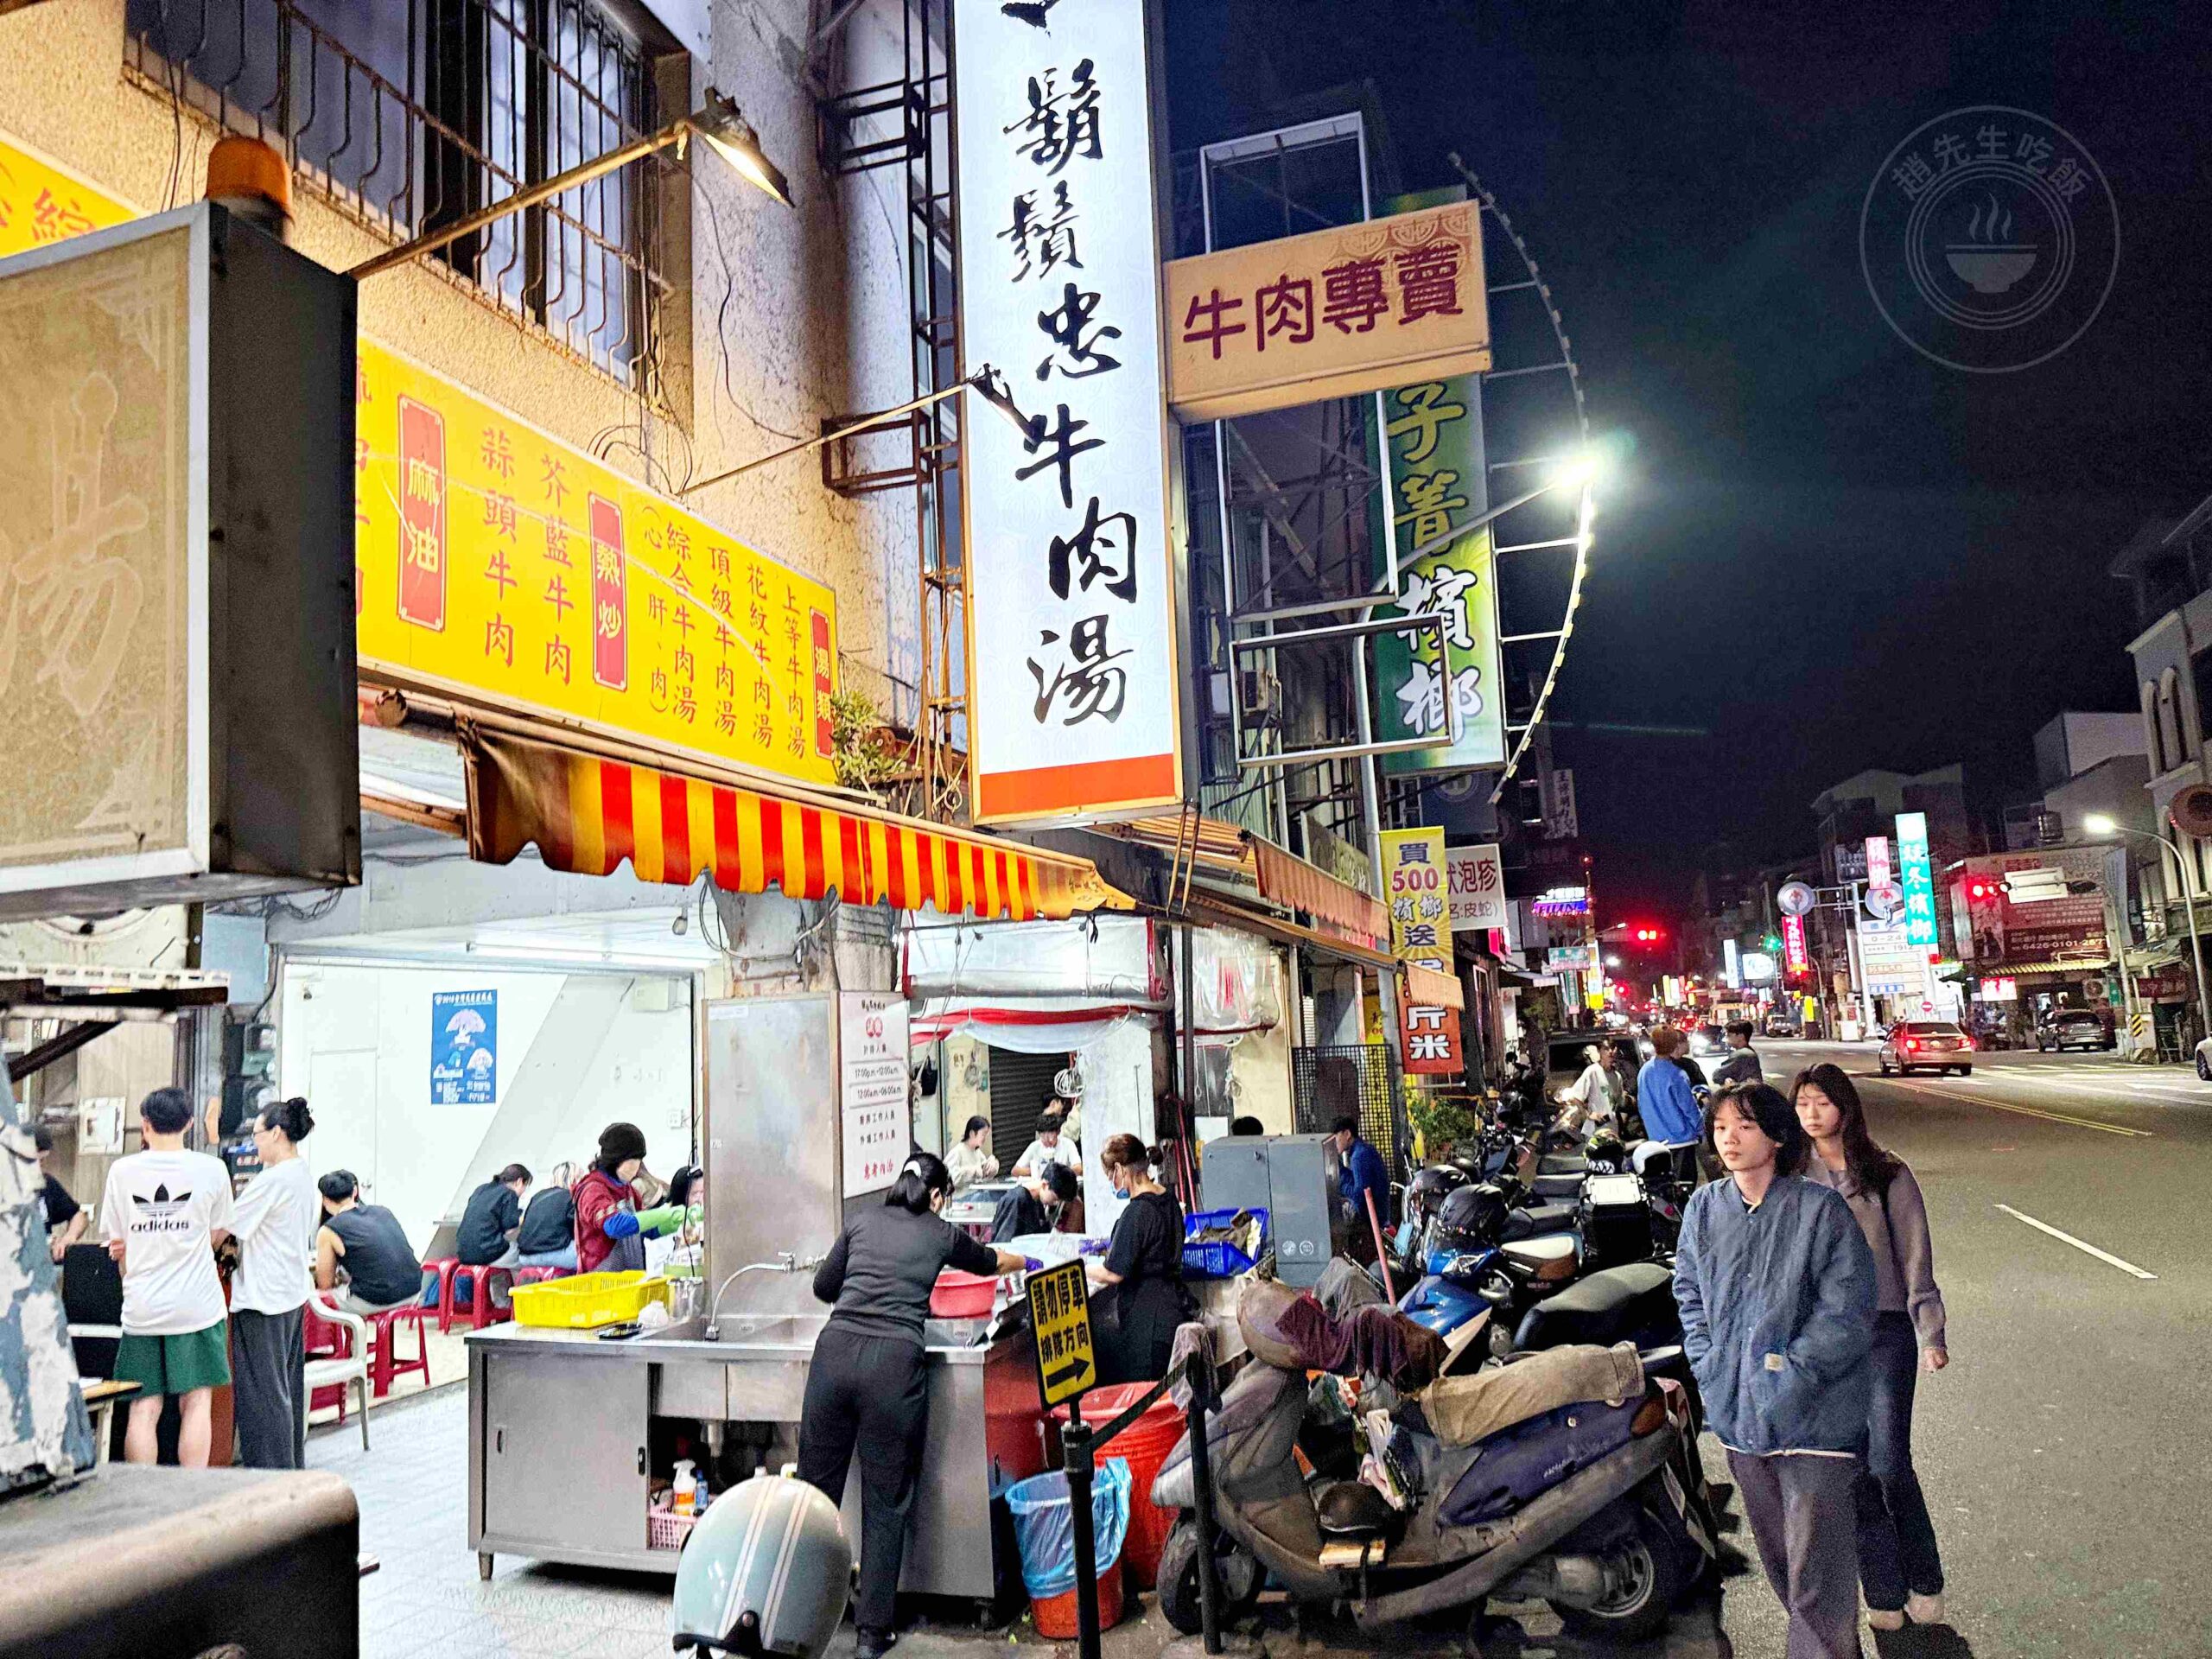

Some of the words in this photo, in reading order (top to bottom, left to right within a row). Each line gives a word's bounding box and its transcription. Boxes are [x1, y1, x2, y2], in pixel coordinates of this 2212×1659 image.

[1183, 243, 1464, 360] 牛肉專賣
[996, 0, 1136, 727] 鬍鬚忠牛肉湯
[407, 455, 439, 574] 麻油
[480, 428, 518, 669] 蒜頭牛肉
[595, 544, 622, 639] 熱炒
[666, 520, 697, 725] 綜合牛肉湯
[708, 545, 738, 737] 頂級牛肉湯
[746, 563, 773, 749] 花紋牛肉湯
[782, 585, 806, 760] 上等牛肉湯
[1391, 866, 1440, 893] 500
[1404, 924, 1437, 947] 送
[130, 1219, 189, 1233] adidas
[1033, 1268, 1084, 1327] 請勿停車
[1039, 1320, 1089, 1364] 排隊方向
